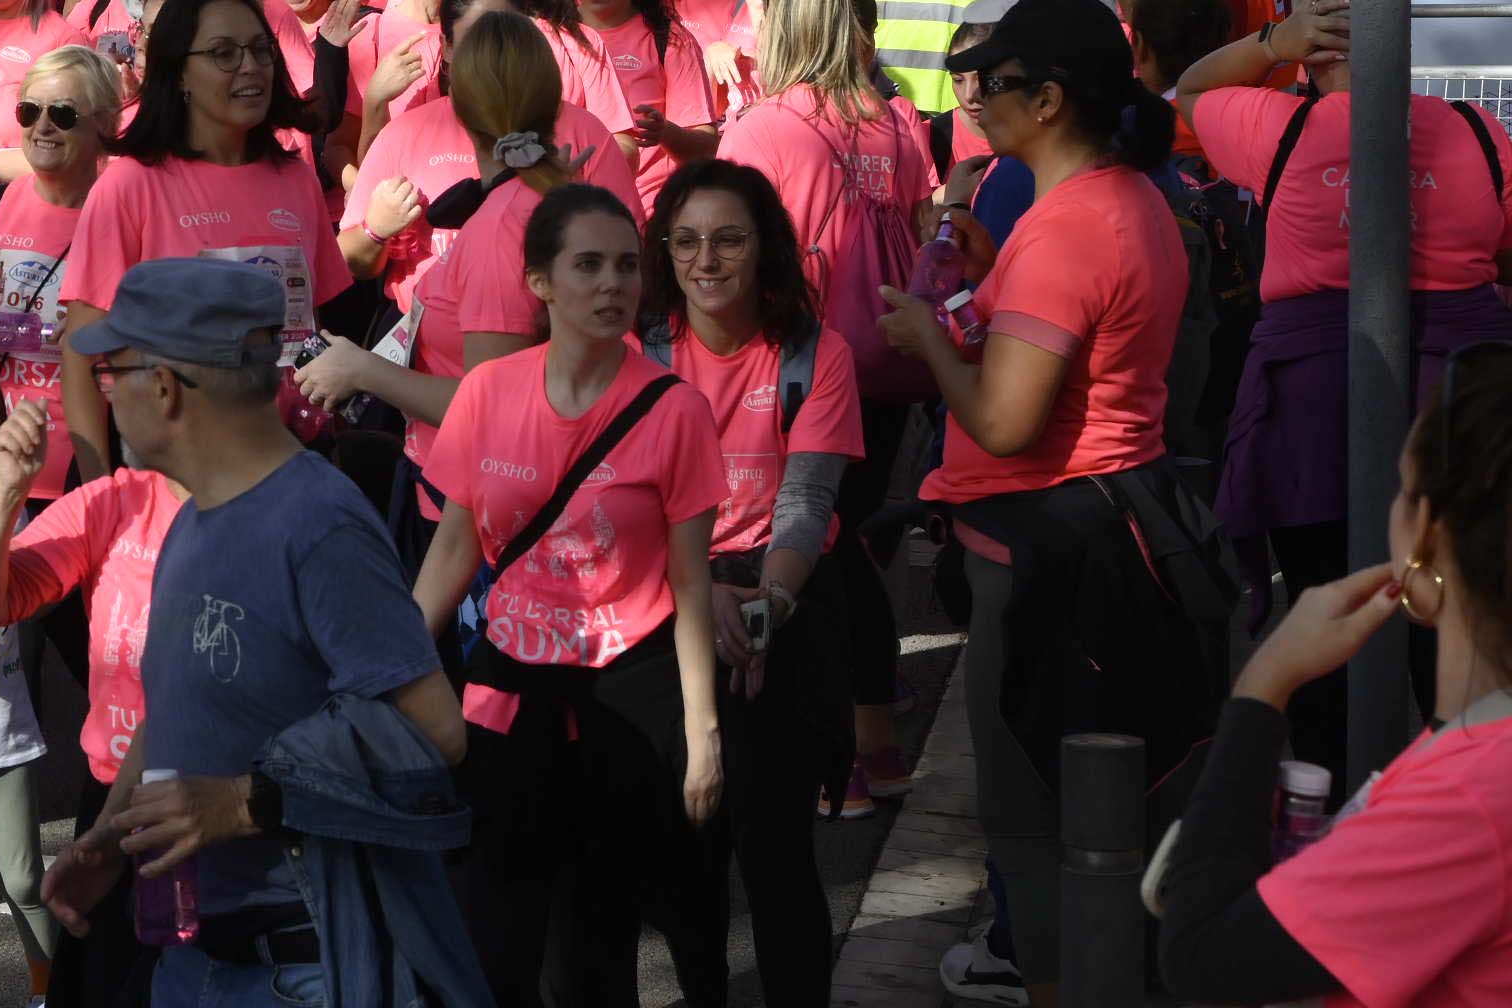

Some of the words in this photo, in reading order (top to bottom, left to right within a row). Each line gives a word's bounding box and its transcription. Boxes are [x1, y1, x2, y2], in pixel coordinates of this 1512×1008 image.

[428, 153, 475, 167] OYSHO
[179, 212, 231, 228] OYSHO
[480, 457, 537, 482] OYSHO
[489, 616, 627, 670] SUMA
[108, 705, 136, 731] TU
